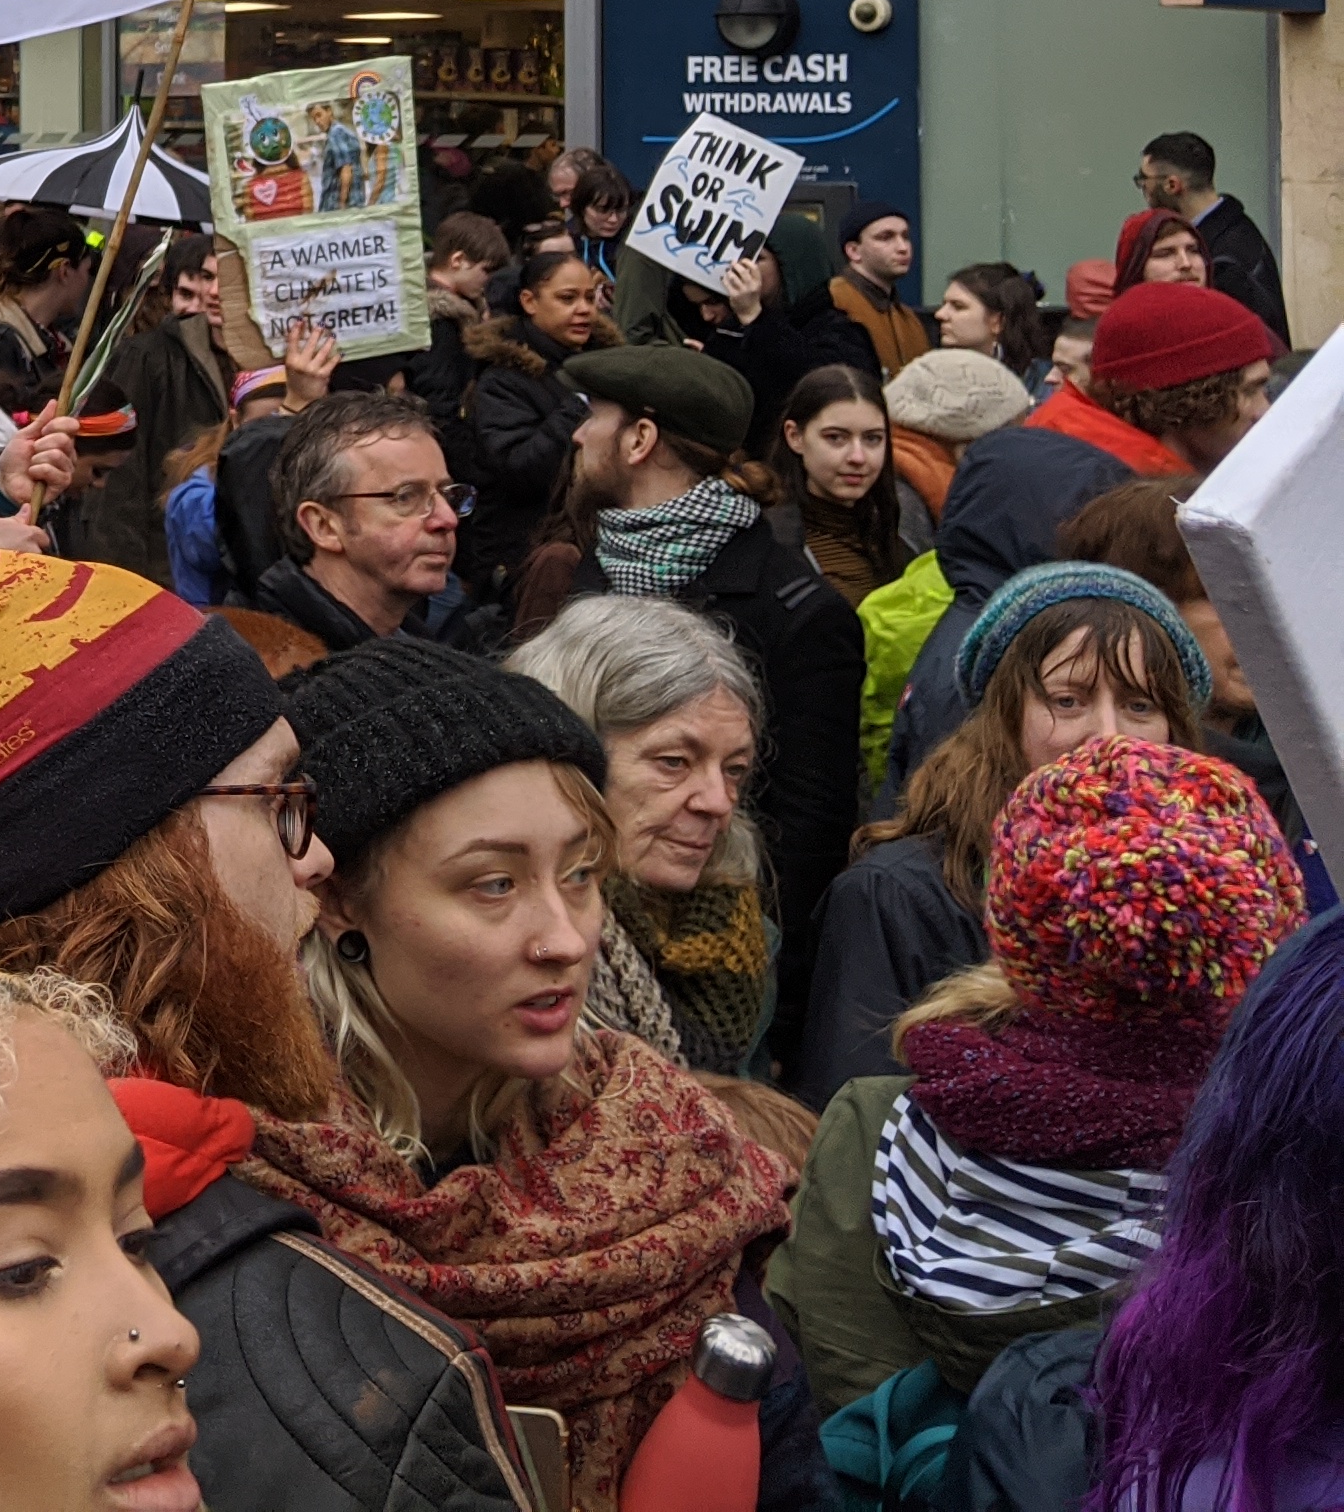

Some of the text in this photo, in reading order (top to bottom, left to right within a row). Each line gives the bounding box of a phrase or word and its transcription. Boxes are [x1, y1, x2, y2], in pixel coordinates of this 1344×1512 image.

[687, 53, 849, 84] FREE CASH
[683, 91, 852, 115] WITHDRAWALS
[687, 130, 784, 191] THINK
[691, 172, 725, 204] OR
[646, 184, 767, 262] SWIM
[270, 235, 386, 270] A WARMER
[274, 269, 388, 303] CLIMATE IS
[321, 301, 397, 330] GRETA!
